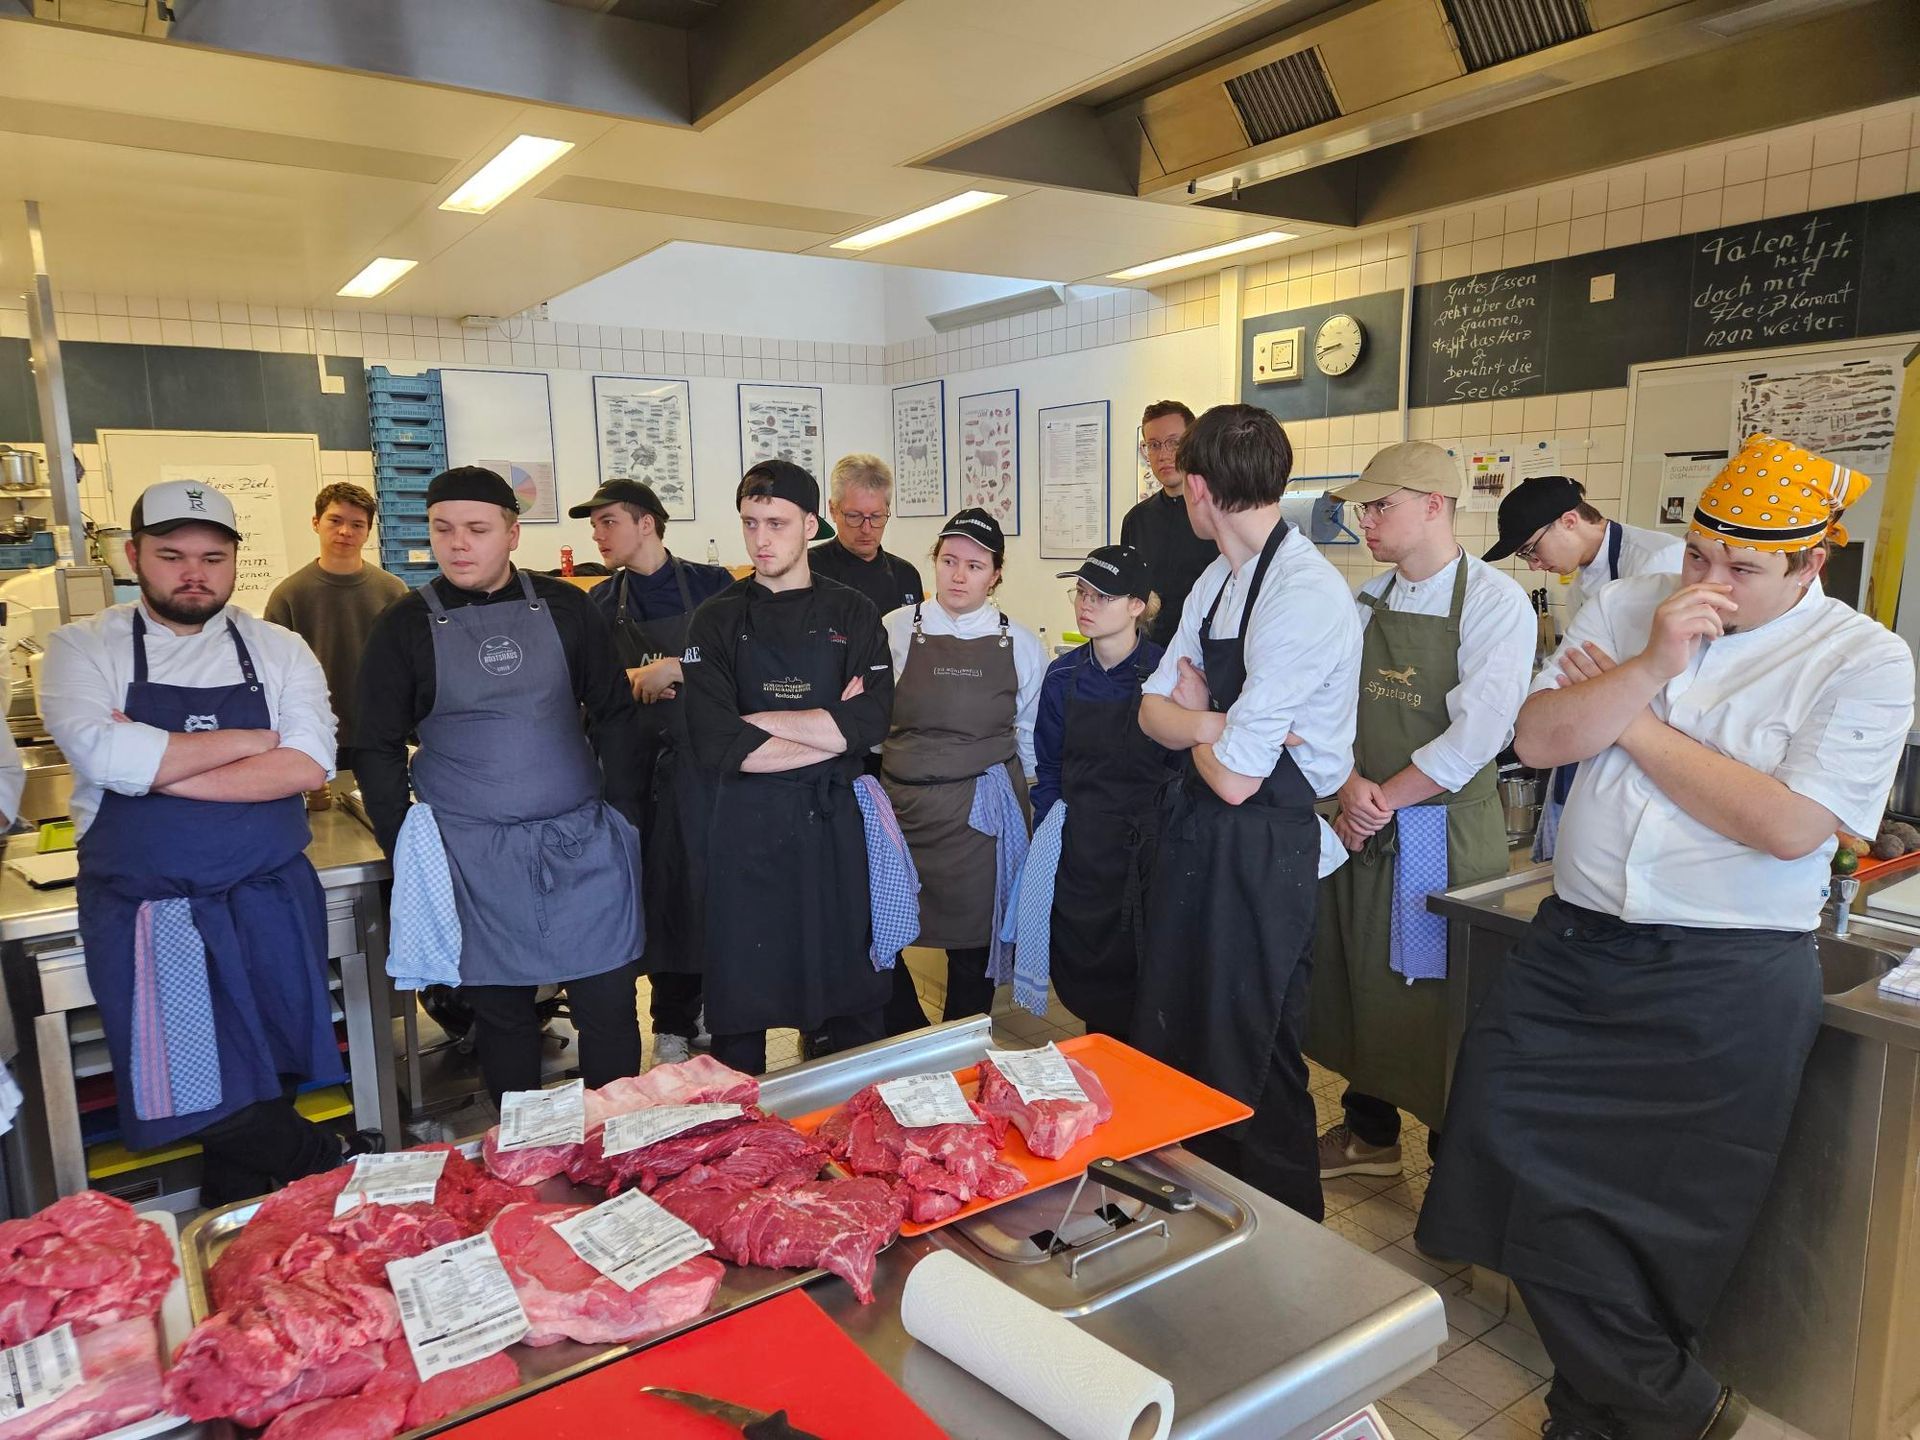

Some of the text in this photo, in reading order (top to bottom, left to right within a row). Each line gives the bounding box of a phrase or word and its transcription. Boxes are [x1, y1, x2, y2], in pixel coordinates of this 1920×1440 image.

[1702, 217, 1832, 265] Talent
[1444, 272, 1537, 305] Gutes Essen
[1694, 267, 1816, 308] doch mit
[1434, 295, 1536, 326] geht über den
[1469, 334, 1496, 348] das
[1496, 329, 1532, 344] Herz
[1704, 311, 1844, 347] man weiter.
[1508, 357, 1532, 374] die
